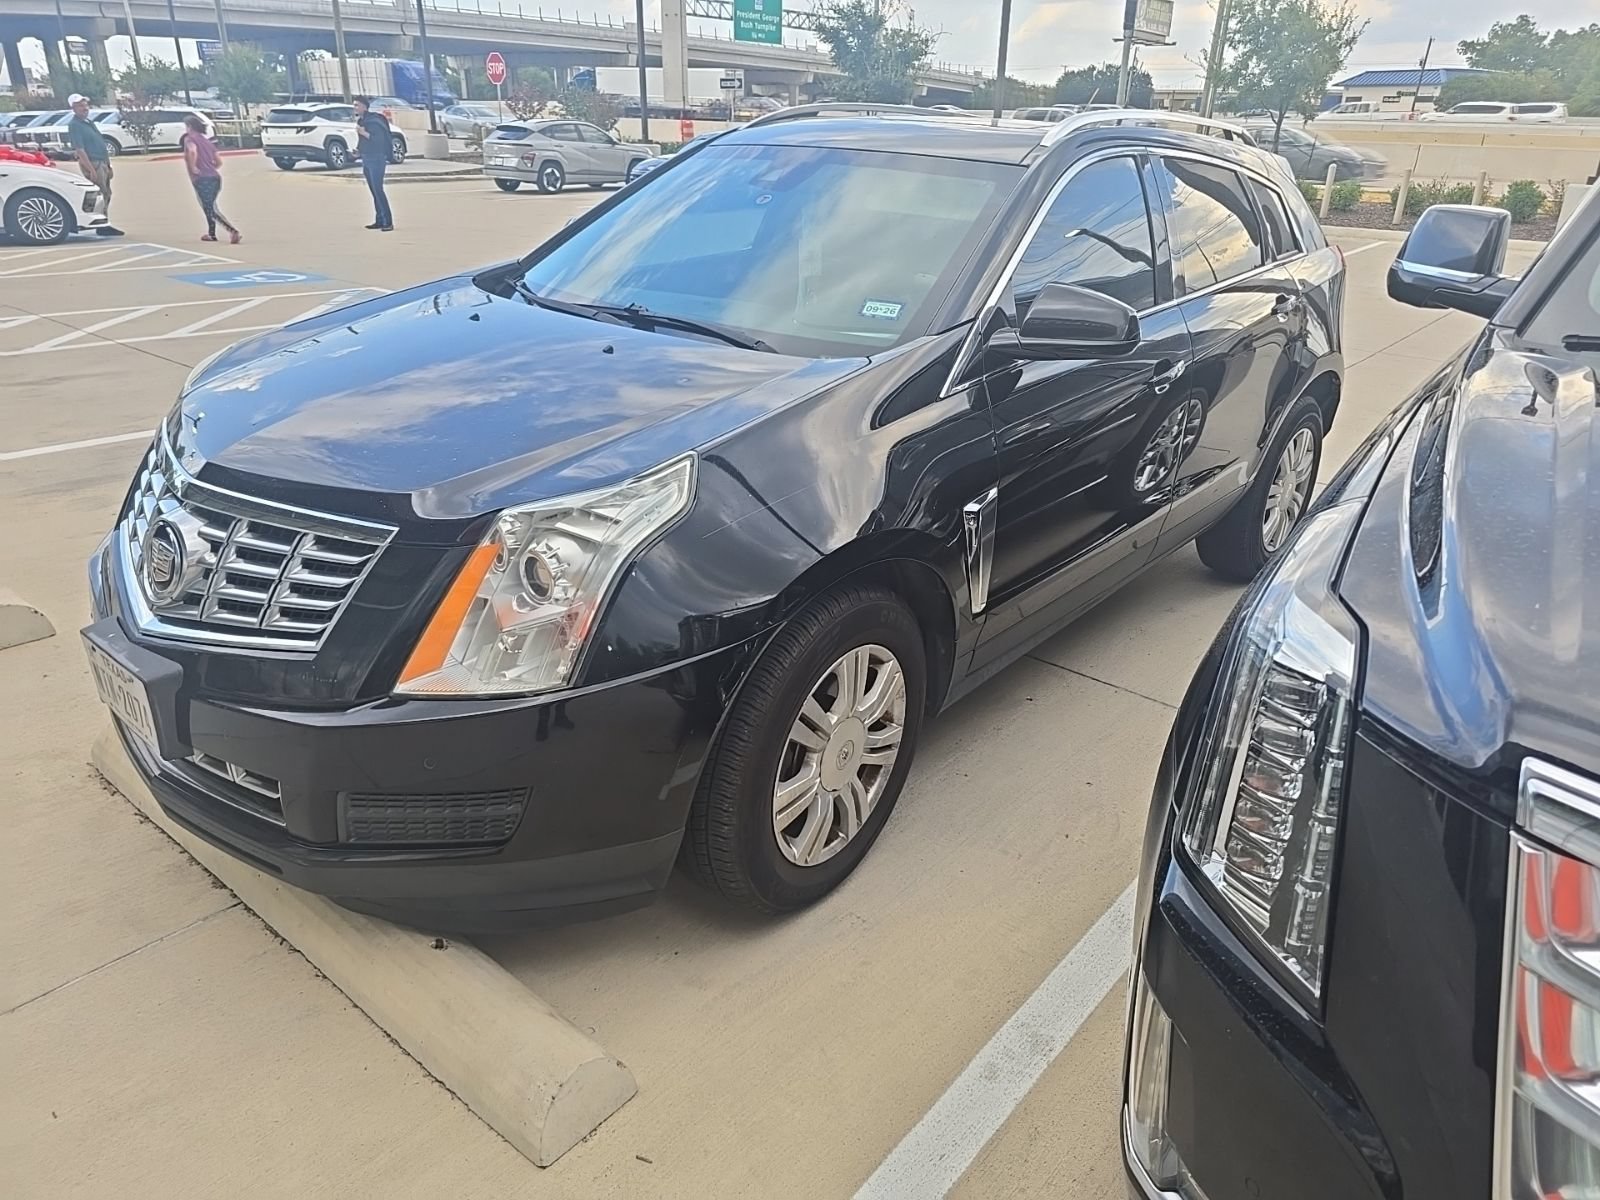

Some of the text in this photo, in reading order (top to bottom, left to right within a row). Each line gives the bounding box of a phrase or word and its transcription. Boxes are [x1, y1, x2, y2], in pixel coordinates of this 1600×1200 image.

[736, 10, 780, 24] President George
[740, 20, 776, 32] Bush Turnpike
[488, 62, 504, 75] STOP
